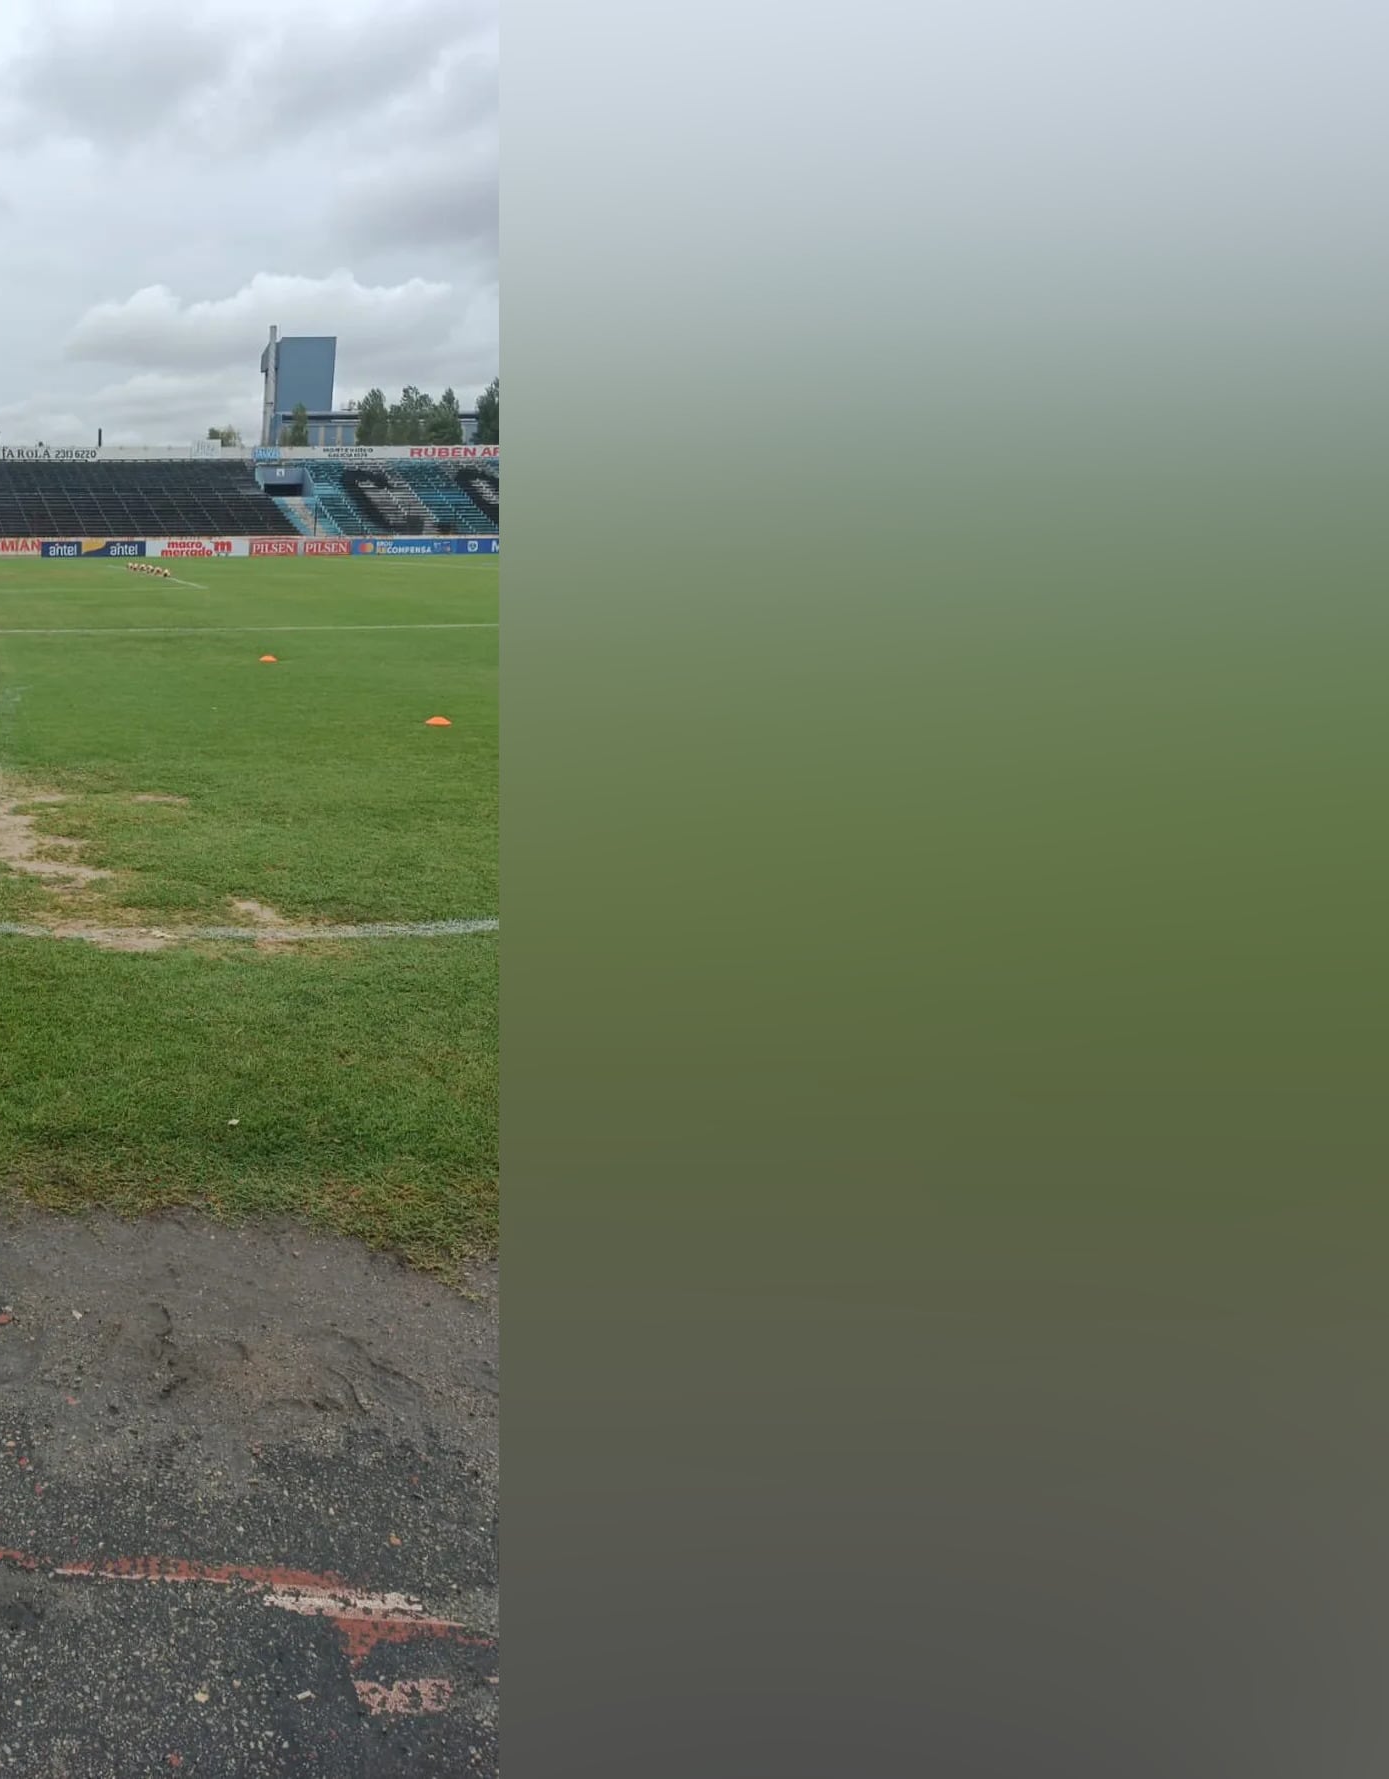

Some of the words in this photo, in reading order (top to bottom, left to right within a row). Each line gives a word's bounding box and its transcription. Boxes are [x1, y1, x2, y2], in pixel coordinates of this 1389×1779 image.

[410, 447, 477, 457] RUBEN
[49, 542, 77, 556] antel
[110, 542, 138, 556] antel
[253, 543, 294, 553] PILSEN
[305, 542, 347, 553] PILSEN
